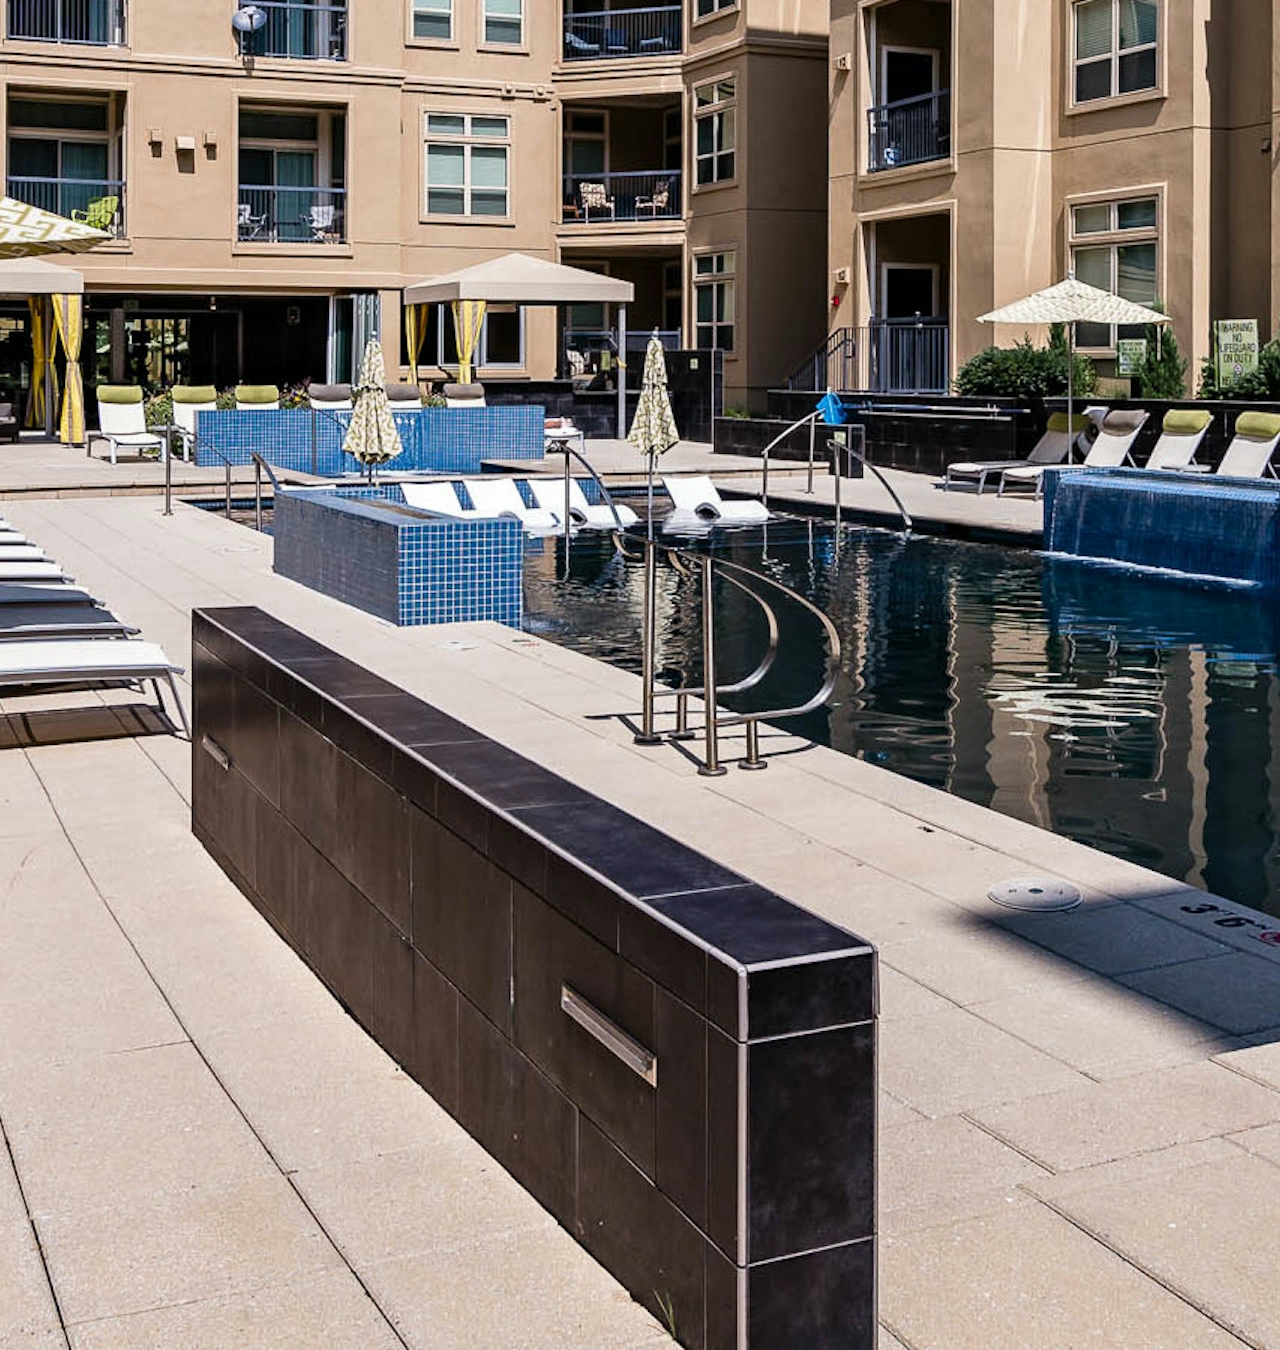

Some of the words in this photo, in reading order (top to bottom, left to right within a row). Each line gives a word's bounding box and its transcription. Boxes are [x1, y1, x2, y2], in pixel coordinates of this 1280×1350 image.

[1221, 322, 1253, 332] WARNING
[1232, 333, 1242, 343] NO
[1220, 343, 1256, 353] LIFEGUARD
[1223, 353, 1233, 363] ON
[1234, 353, 1253, 364] DUTY
